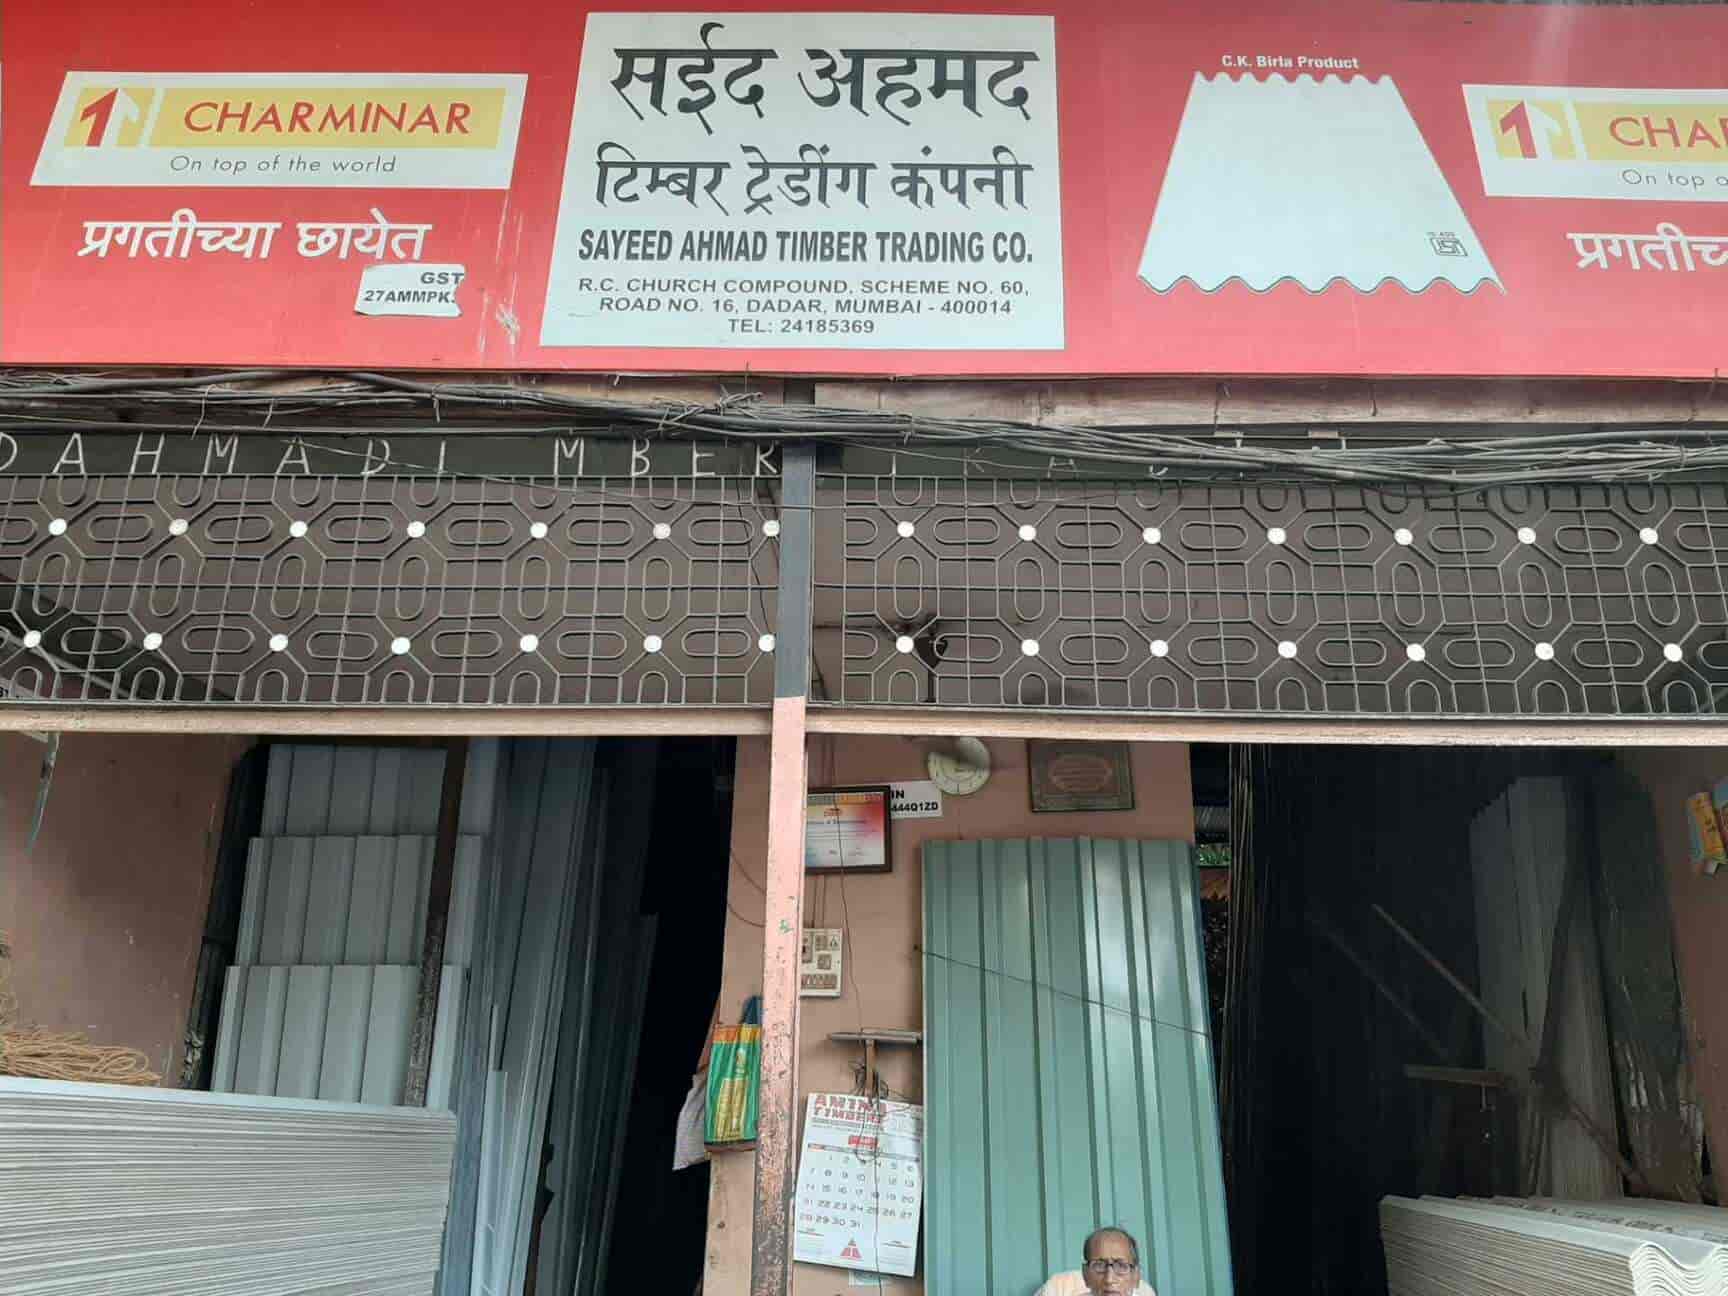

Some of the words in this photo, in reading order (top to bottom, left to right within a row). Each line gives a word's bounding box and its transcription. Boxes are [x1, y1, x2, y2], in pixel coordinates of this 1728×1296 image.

[1221, 55, 1253, 67] C.K.
[1256, 55, 1293, 67] Birla
[1297, 56, 1359, 69] Product
[610, 22, 779, 136] सईद
[798, 48, 1040, 126] अहमद
[183, 102, 472, 134] CHARMINAR
[1608, 116, 1728, 149] CHA
[170, 155, 202, 172] On
[213, 157, 247, 174] top
[257, 155, 281, 172] of
[288, 155, 321, 172] the
[332, 155, 397, 173] world
[596, 142, 731, 216] टिम्बर
[890, 145, 1034, 210] कंपनी
[1621, 168, 1657, 185] On
[1667, 171, 1705, 190] top
[78, 208, 282, 259] प्रगतीच्या
[296, 207, 433, 259] छायेत
[578, 229, 673, 261] SAYEED
[679, 231, 768, 262] AHMAD
[775, 231, 868, 262] TIMBER
[875, 231, 984, 263] TRADING
[992, 231, 1033, 263] CO.
[420, 271, 465, 285] GST
[578, 277, 619, 292] R.C.
[626, 278, 716, 293] CHURCH
[860, 280, 950, 294] SCHEME
[957, 280, 993, 295] NO.
[1000, 280, 1029, 297] 60,
[364, 290, 456, 304] 27AMMPK
[599, 297, 661, 312] ROAD
[667, 298, 704, 312] NO.
[712, 298, 739, 315] 16,
[746, 299, 827, 315] DADAR,
[835, 299, 921, 314] MUMBAI
[940, 300, 1011, 314] 400014
[728, 318, 772, 333] TEL:
[780, 319, 875, 334] 24185369
